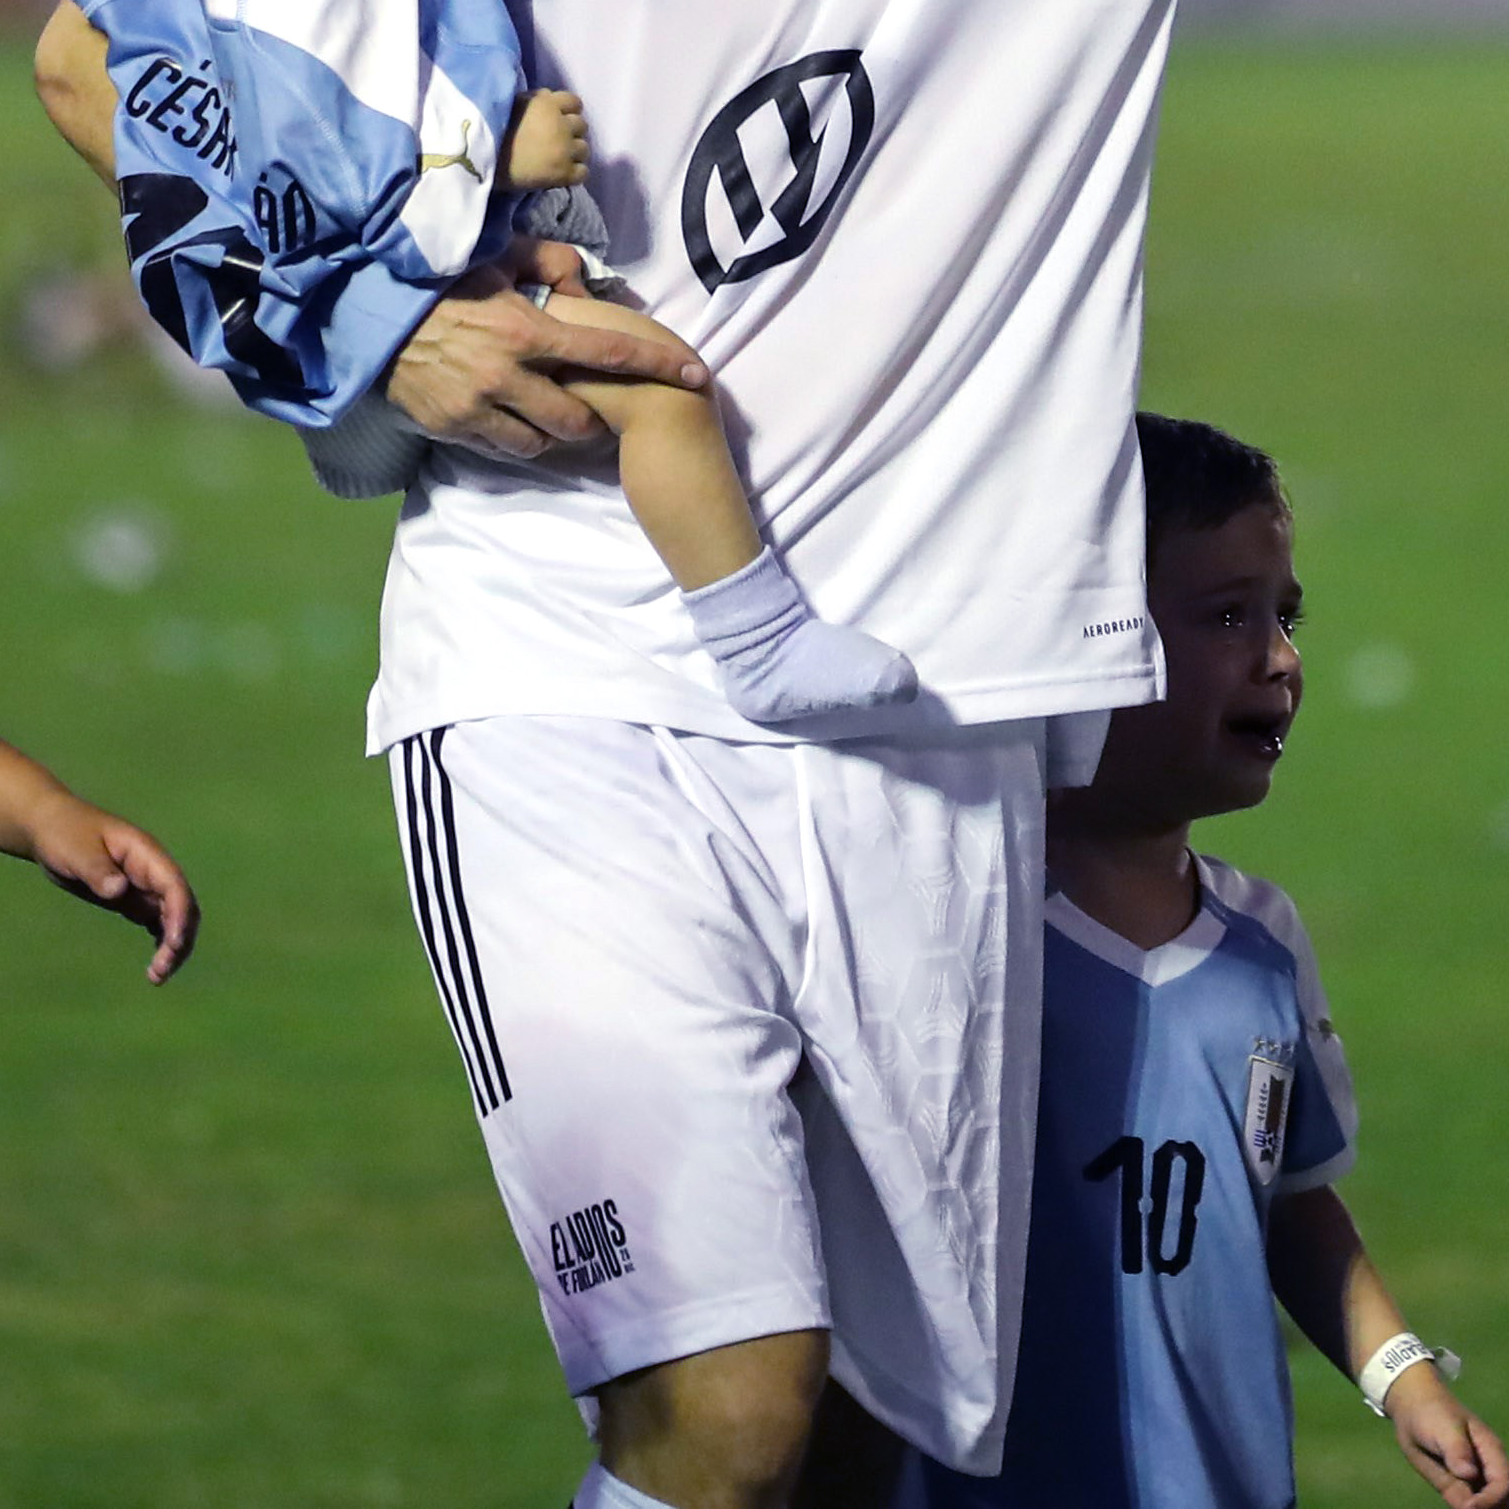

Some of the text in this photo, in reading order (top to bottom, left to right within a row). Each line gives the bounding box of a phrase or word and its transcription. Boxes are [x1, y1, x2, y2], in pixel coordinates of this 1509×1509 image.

[1083, 617, 1144, 639] AEROREADY
[1082, 1135, 1207, 1277] 10
[550, 1221, 576, 1272] EL
